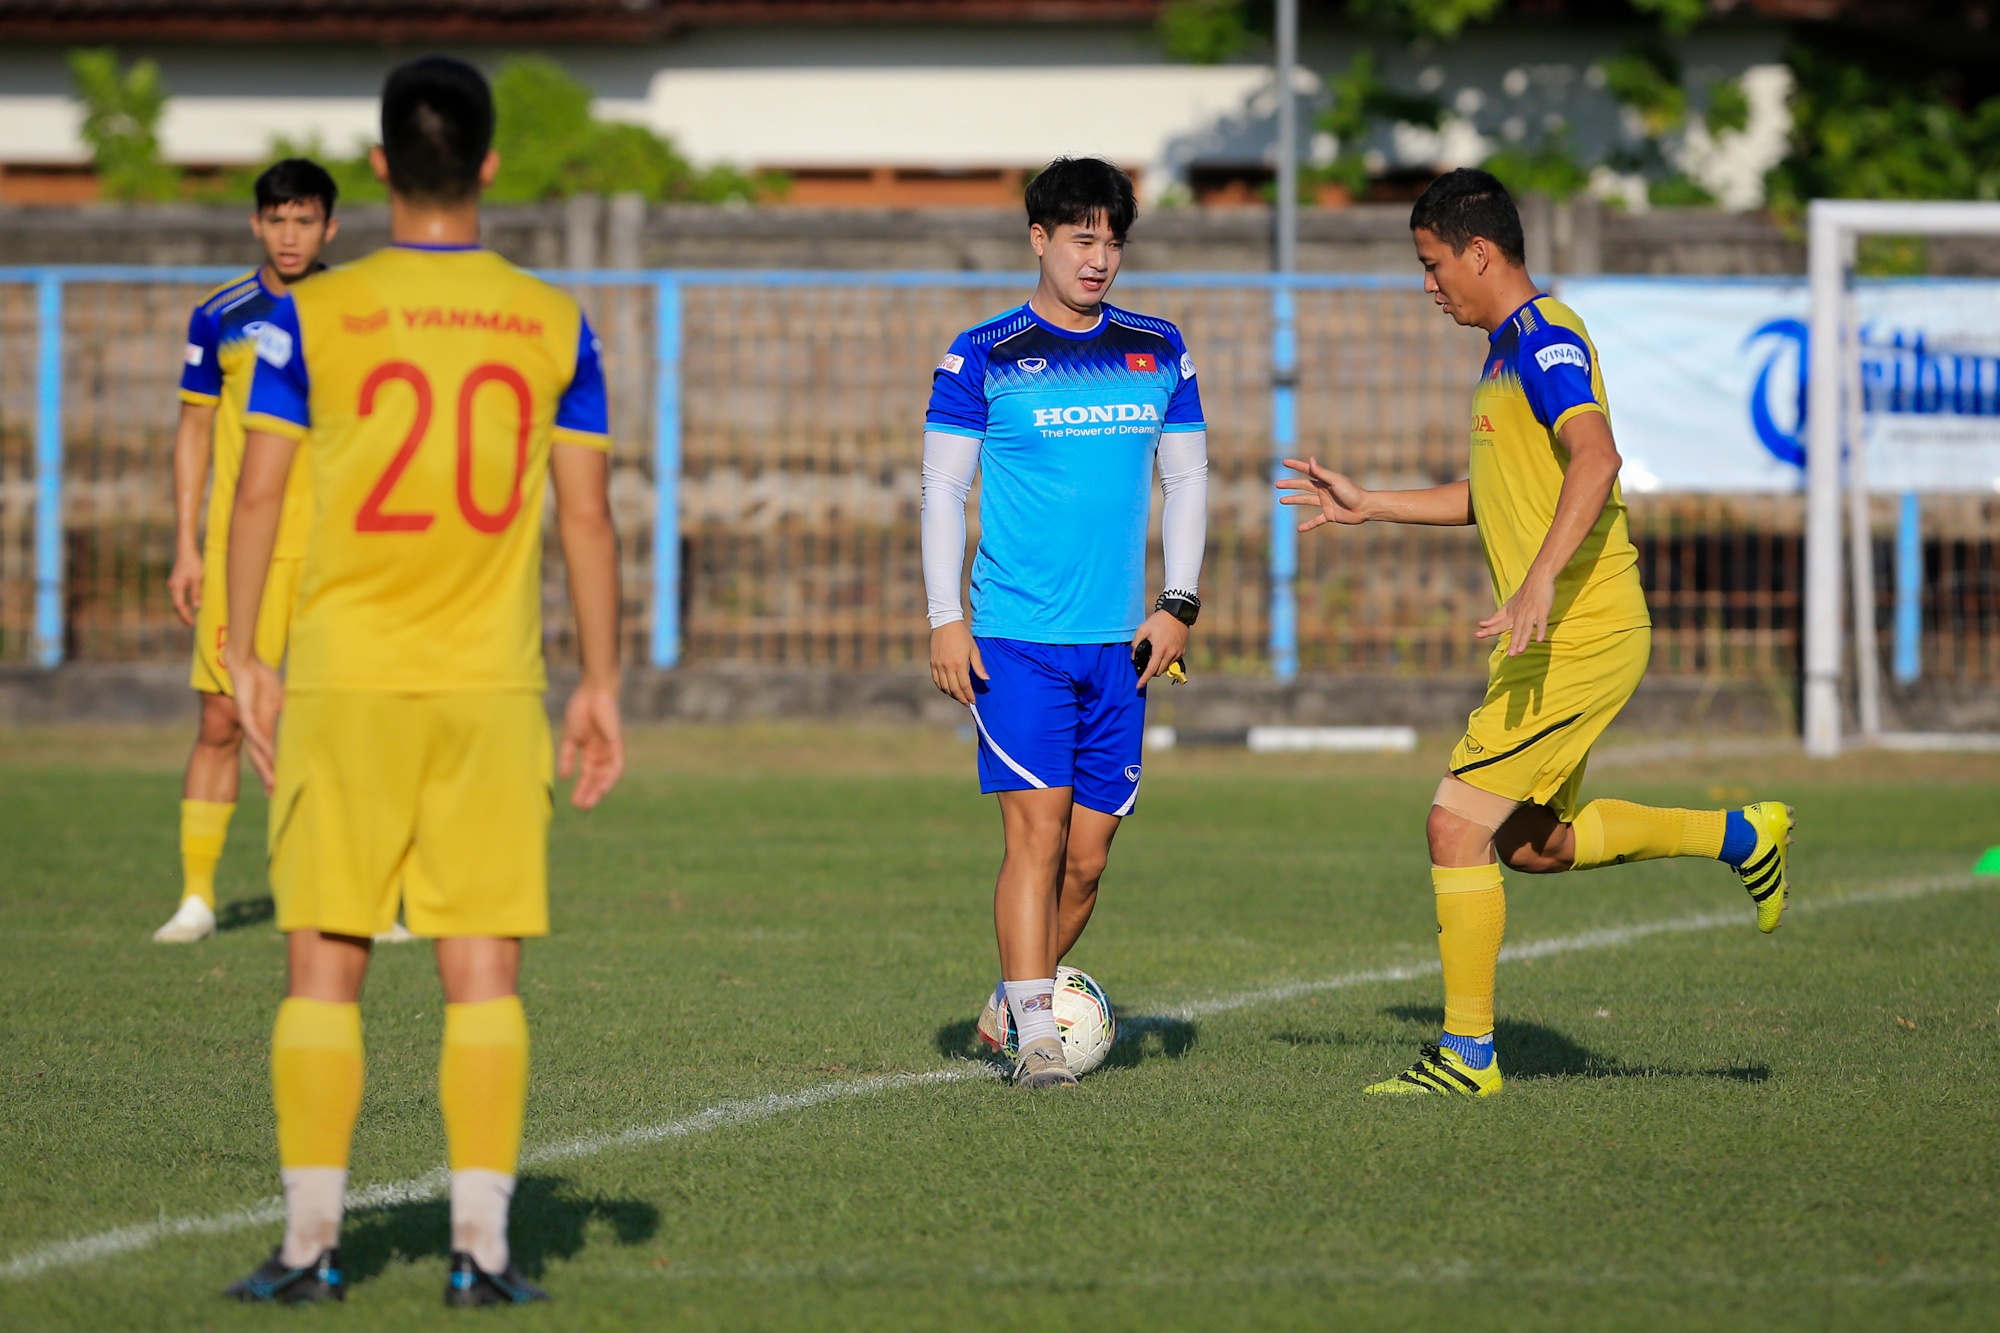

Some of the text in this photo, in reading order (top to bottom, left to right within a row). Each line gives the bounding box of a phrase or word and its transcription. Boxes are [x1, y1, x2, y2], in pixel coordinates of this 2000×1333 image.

[403, 307, 543, 336] YANMAR
[1033, 404, 1159, 427] HONDA
[1040, 424, 1155, 438] The Power of Dreams
[355, 361, 533, 533] 20
